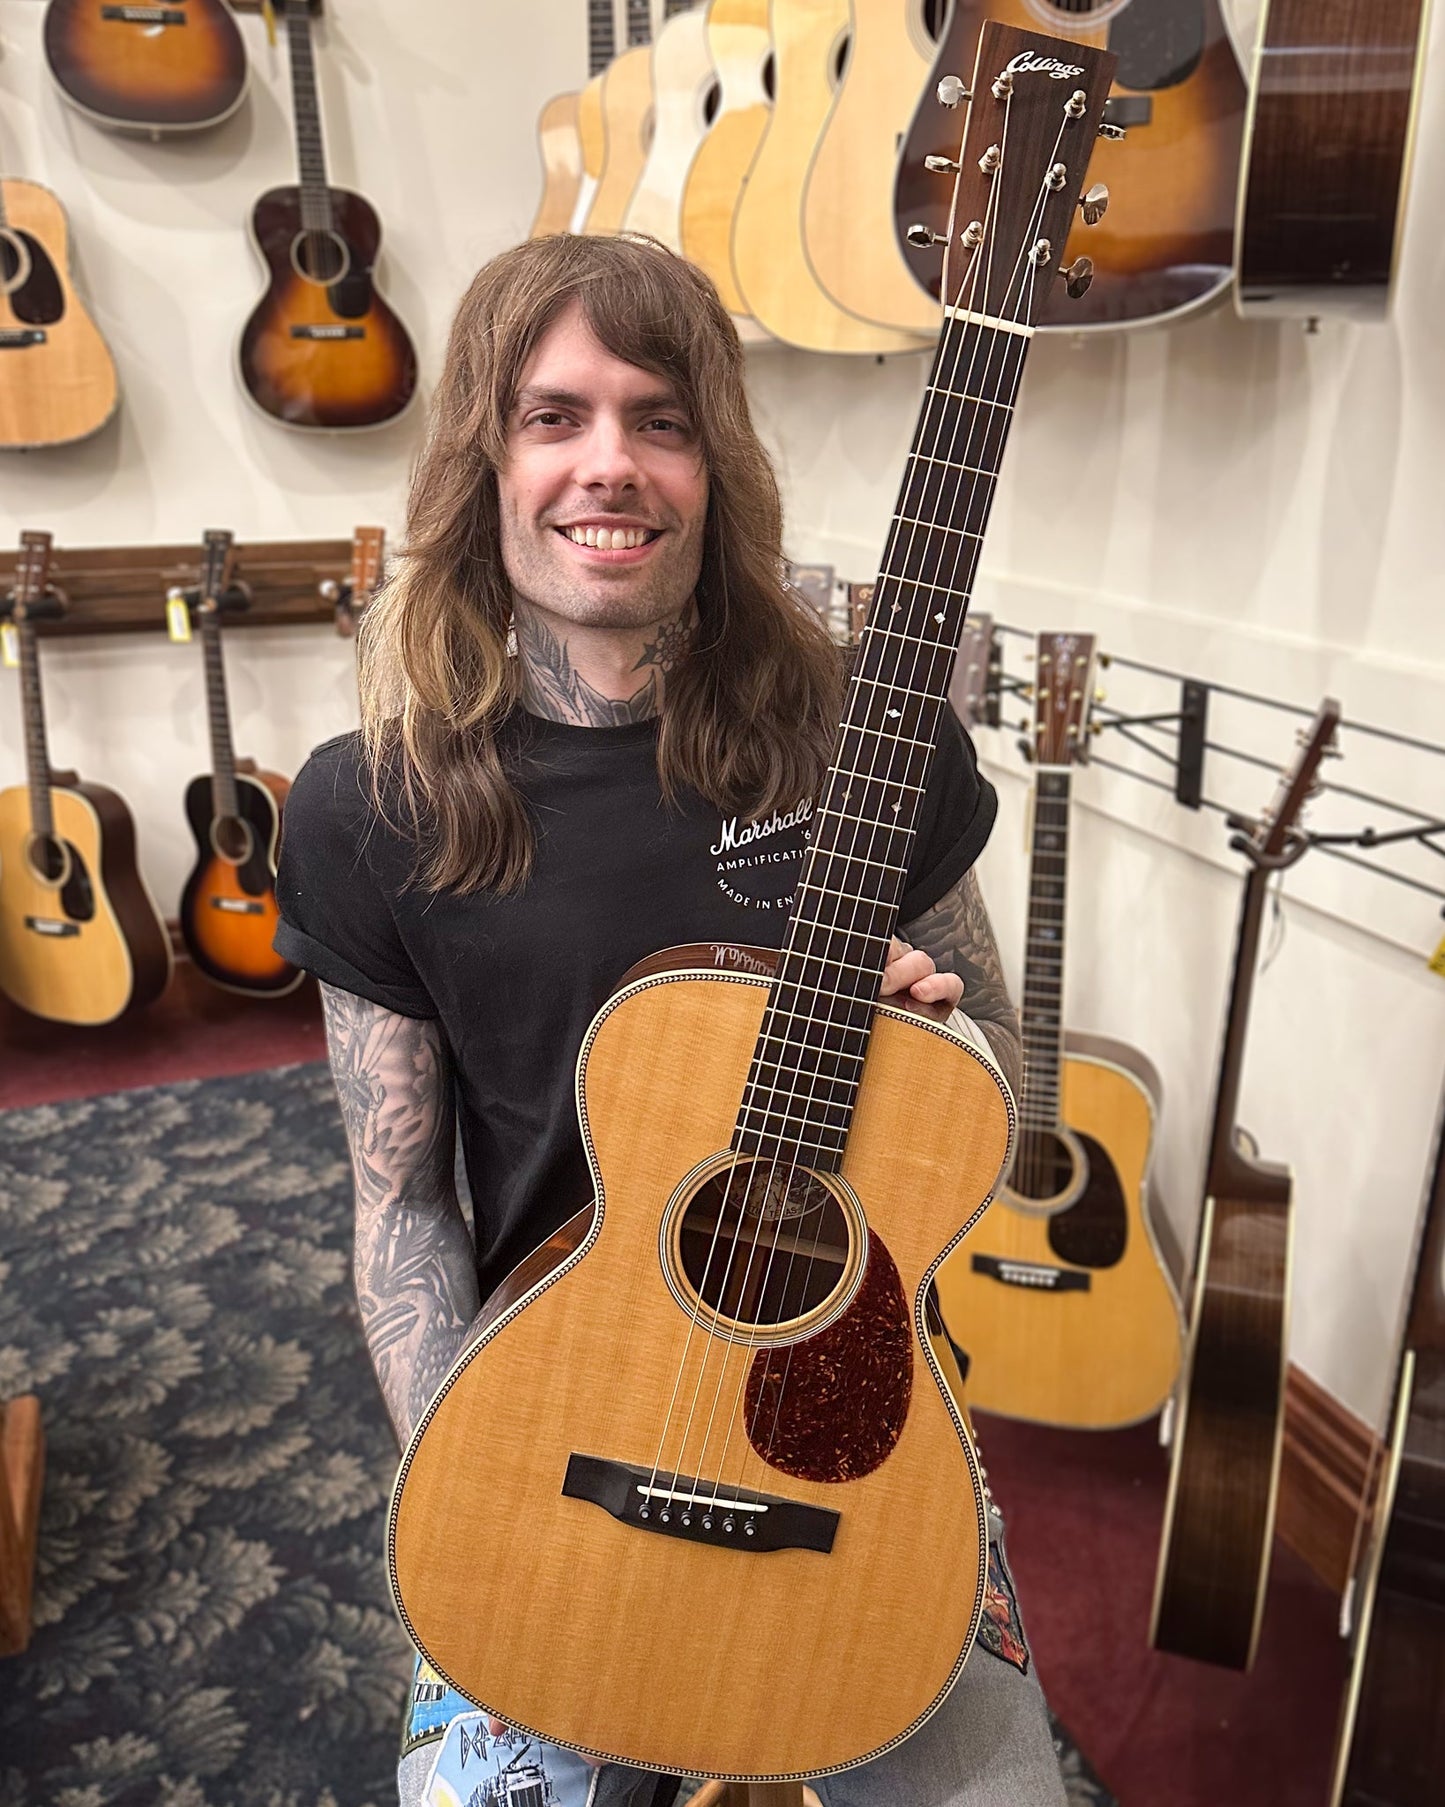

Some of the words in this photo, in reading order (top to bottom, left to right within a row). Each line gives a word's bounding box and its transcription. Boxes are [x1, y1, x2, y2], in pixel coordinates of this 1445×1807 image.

[1006, 50, 1085, 79] Collings
[709, 796, 813, 855] Marshall
[801, 829, 812, 840] '6
[717, 878, 750, 907] MADE
[756, 900, 770, 910] IN
[777, 895, 794, 908] EN
[769, 1206, 798, 1217] TEAS
